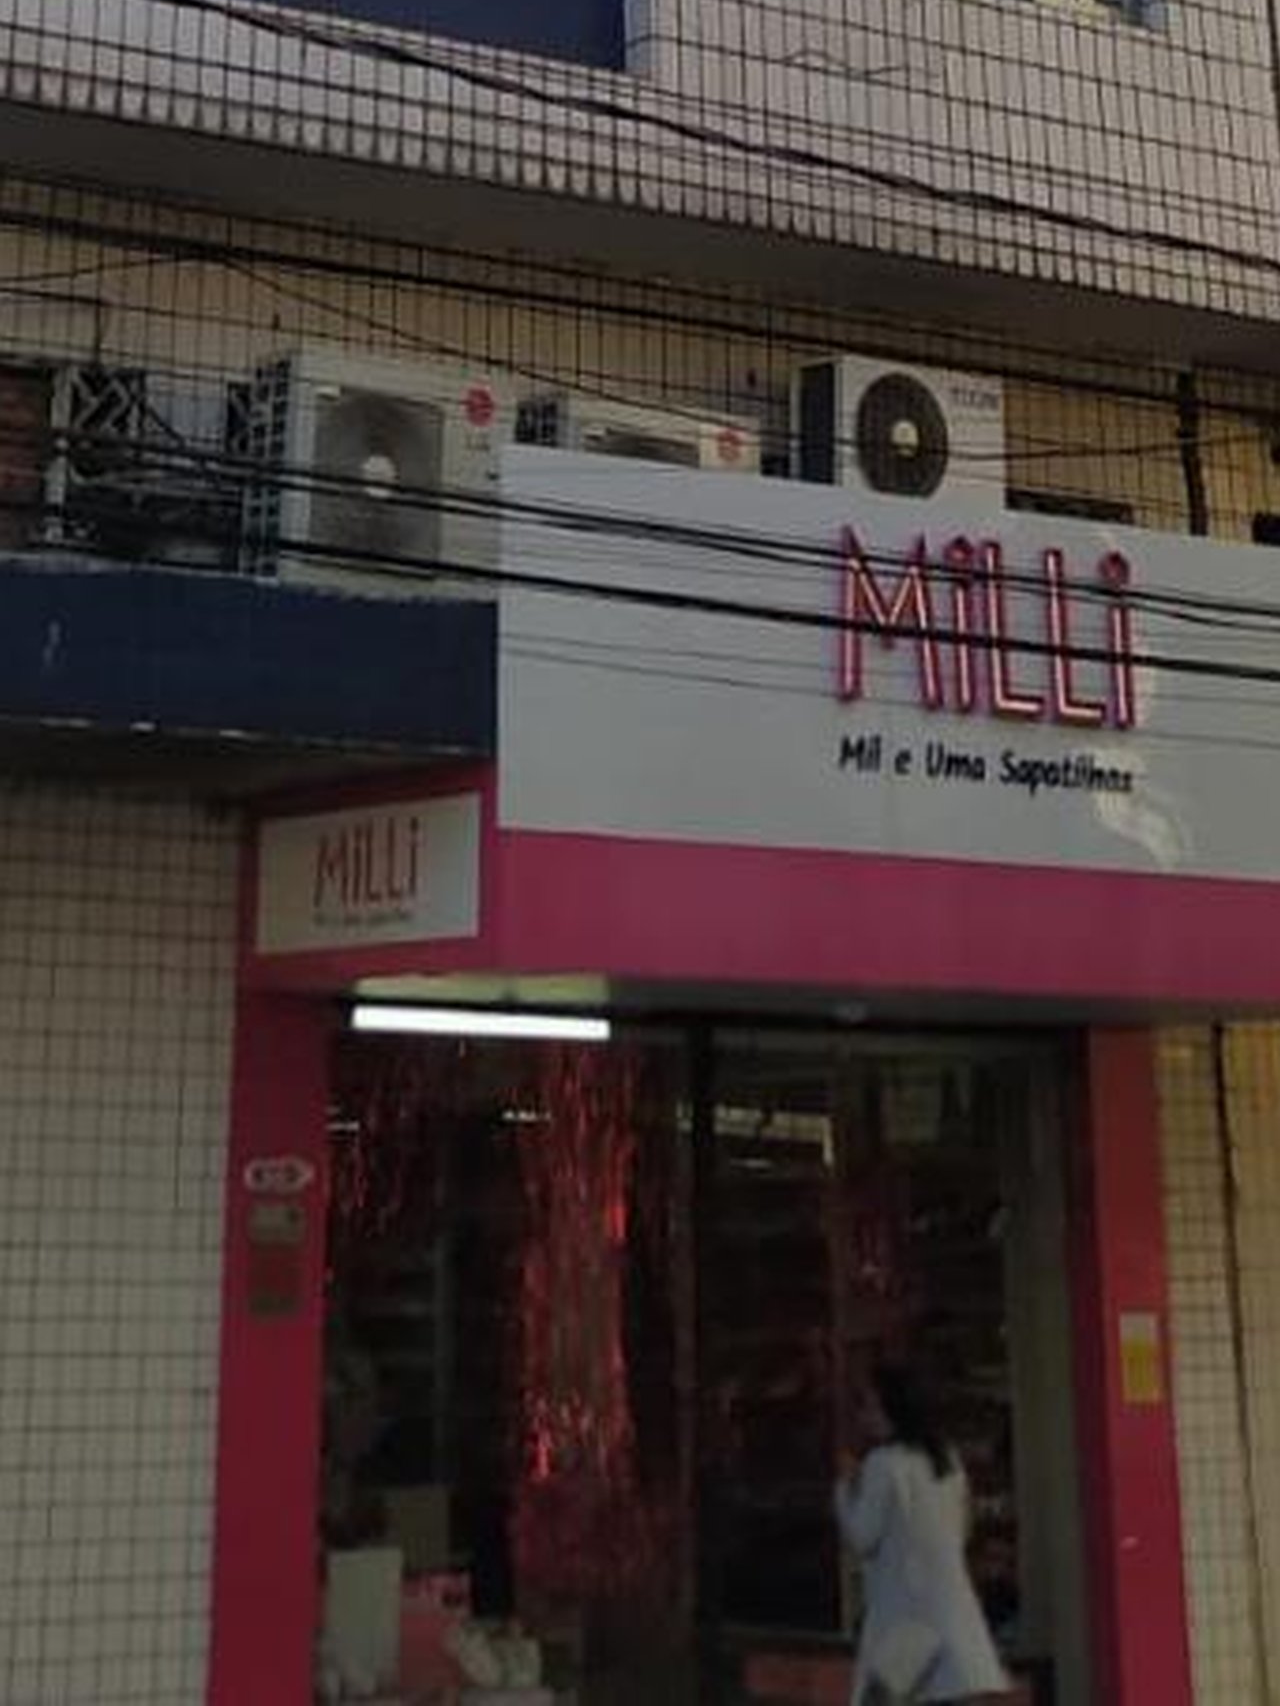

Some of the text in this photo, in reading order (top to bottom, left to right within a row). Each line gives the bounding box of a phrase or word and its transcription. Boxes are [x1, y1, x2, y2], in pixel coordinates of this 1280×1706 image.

[839, 735, 882, 777] Mil
[893, 752, 913, 777] e
[925, 741, 987, 782] Uma
